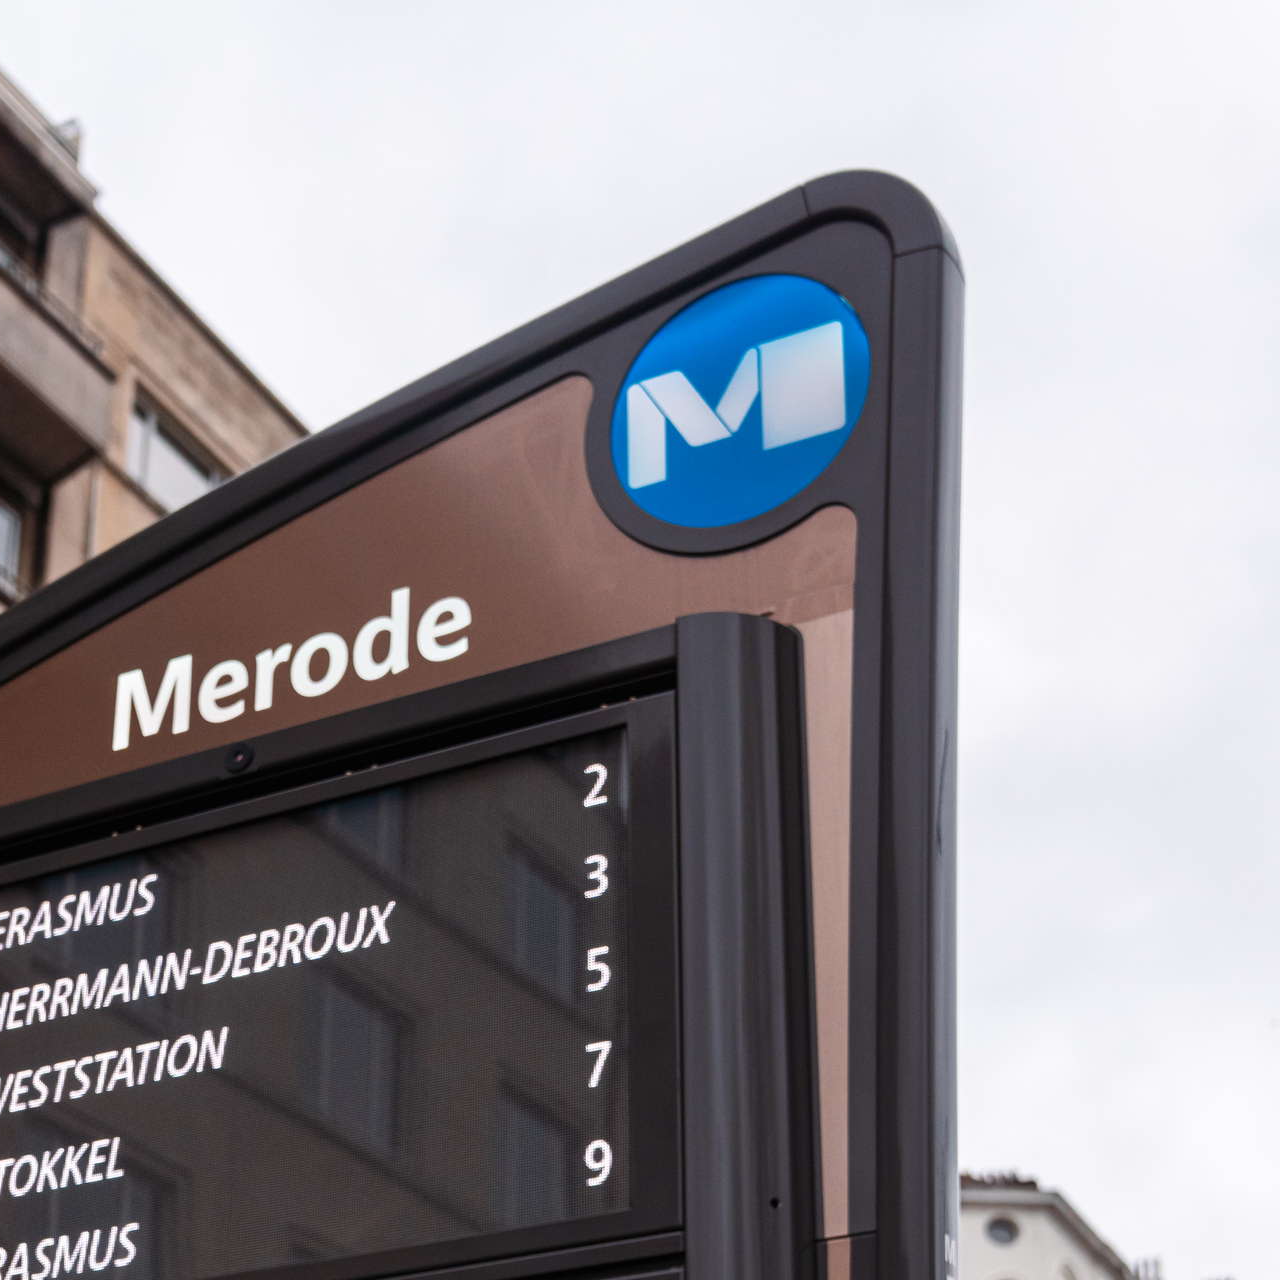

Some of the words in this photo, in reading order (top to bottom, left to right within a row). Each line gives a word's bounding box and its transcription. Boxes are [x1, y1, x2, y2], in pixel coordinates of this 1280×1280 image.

[112, 587, 472, 751] Merode
[584, 764, 607, 807] 2
[584, 854, 608, 898] 3
[587, 946, 611, 992] 5
[586, 1041, 612, 1087] 7
[584, 1140, 612, 1186] 9
